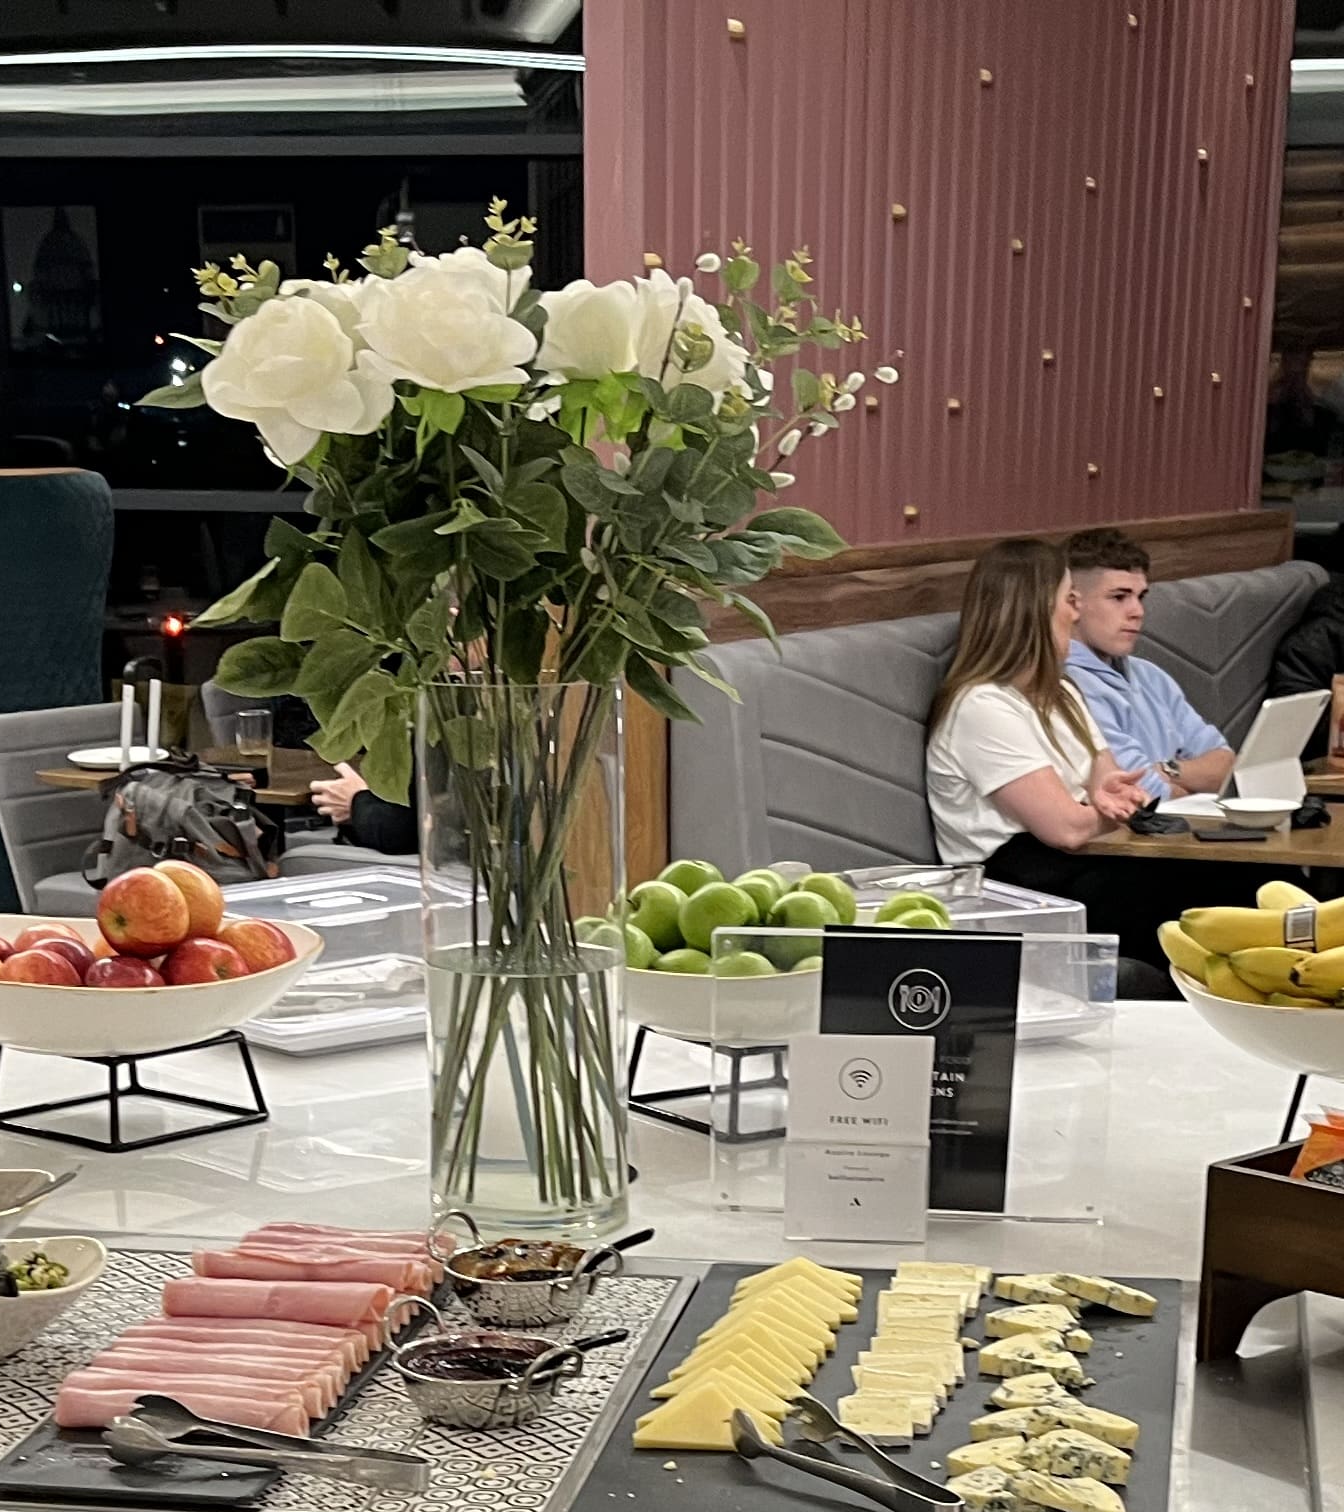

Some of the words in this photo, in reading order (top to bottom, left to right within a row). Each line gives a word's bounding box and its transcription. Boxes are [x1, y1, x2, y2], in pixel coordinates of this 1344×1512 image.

[932, 1071, 965, 1082] TAIN
[930, 1087, 954, 1098] ENS
[829, 1115, 857, 1125] FREE
